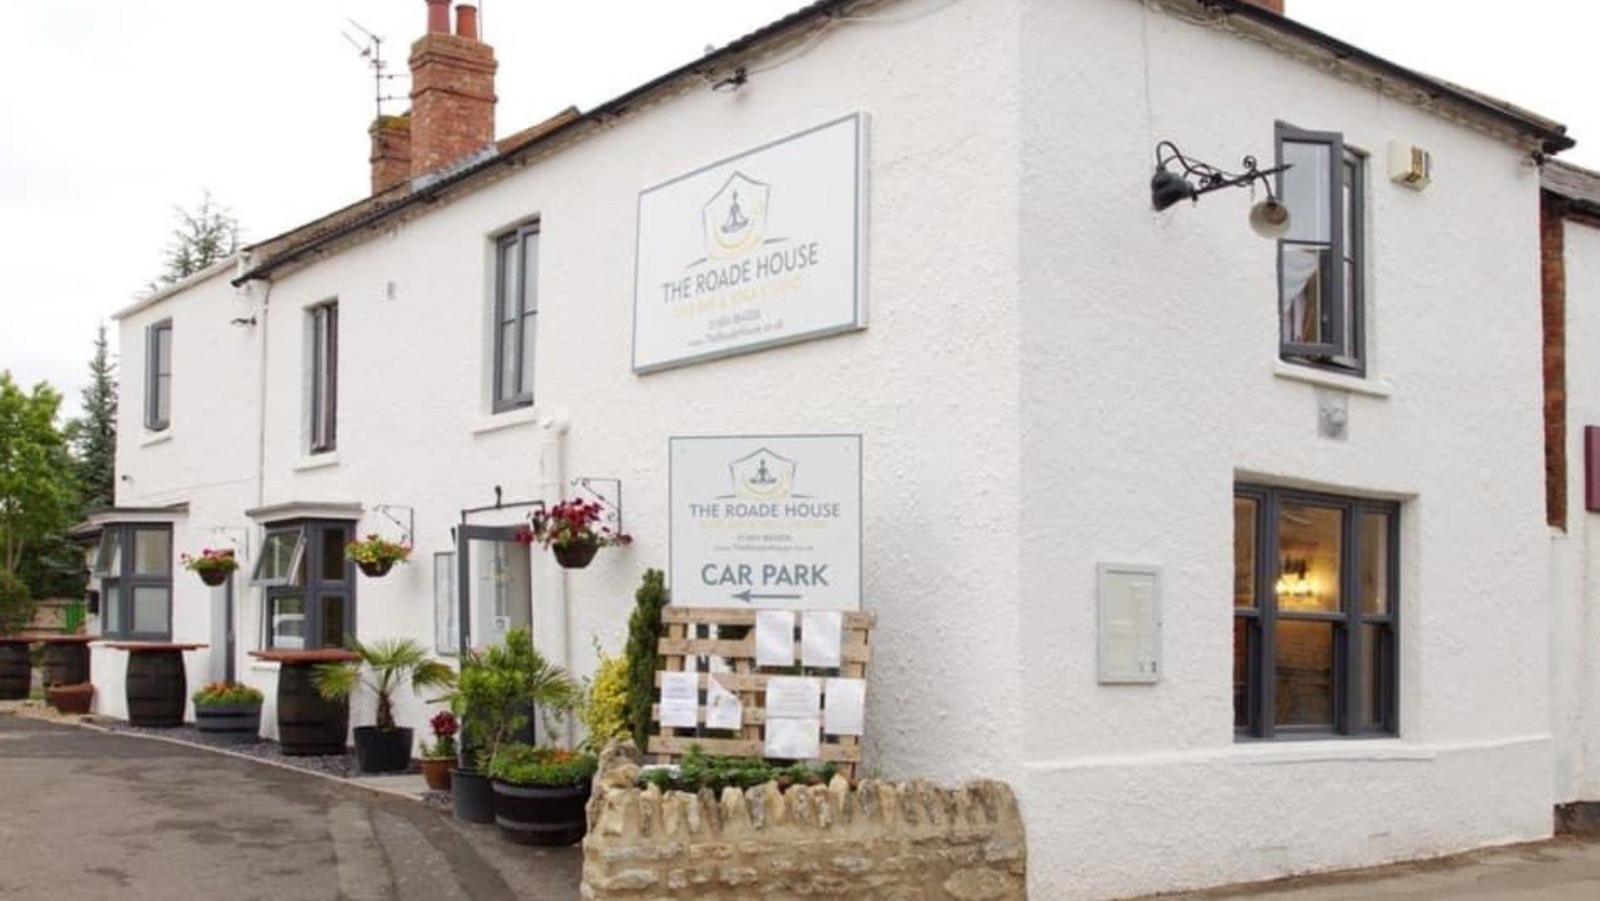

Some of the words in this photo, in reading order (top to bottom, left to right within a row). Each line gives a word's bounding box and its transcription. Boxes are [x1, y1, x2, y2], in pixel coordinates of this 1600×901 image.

[662, 276, 692, 304] THE
[696, 259, 751, 293] ROADE
[756, 243, 819, 279] HOUSE
[690, 503, 720, 518] THE
[725, 503, 781, 518] ROADE
[785, 503, 841, 518] HOUSE
[701, 563, 753, 586] CAR
[762, 563, 830, 586] PARK
